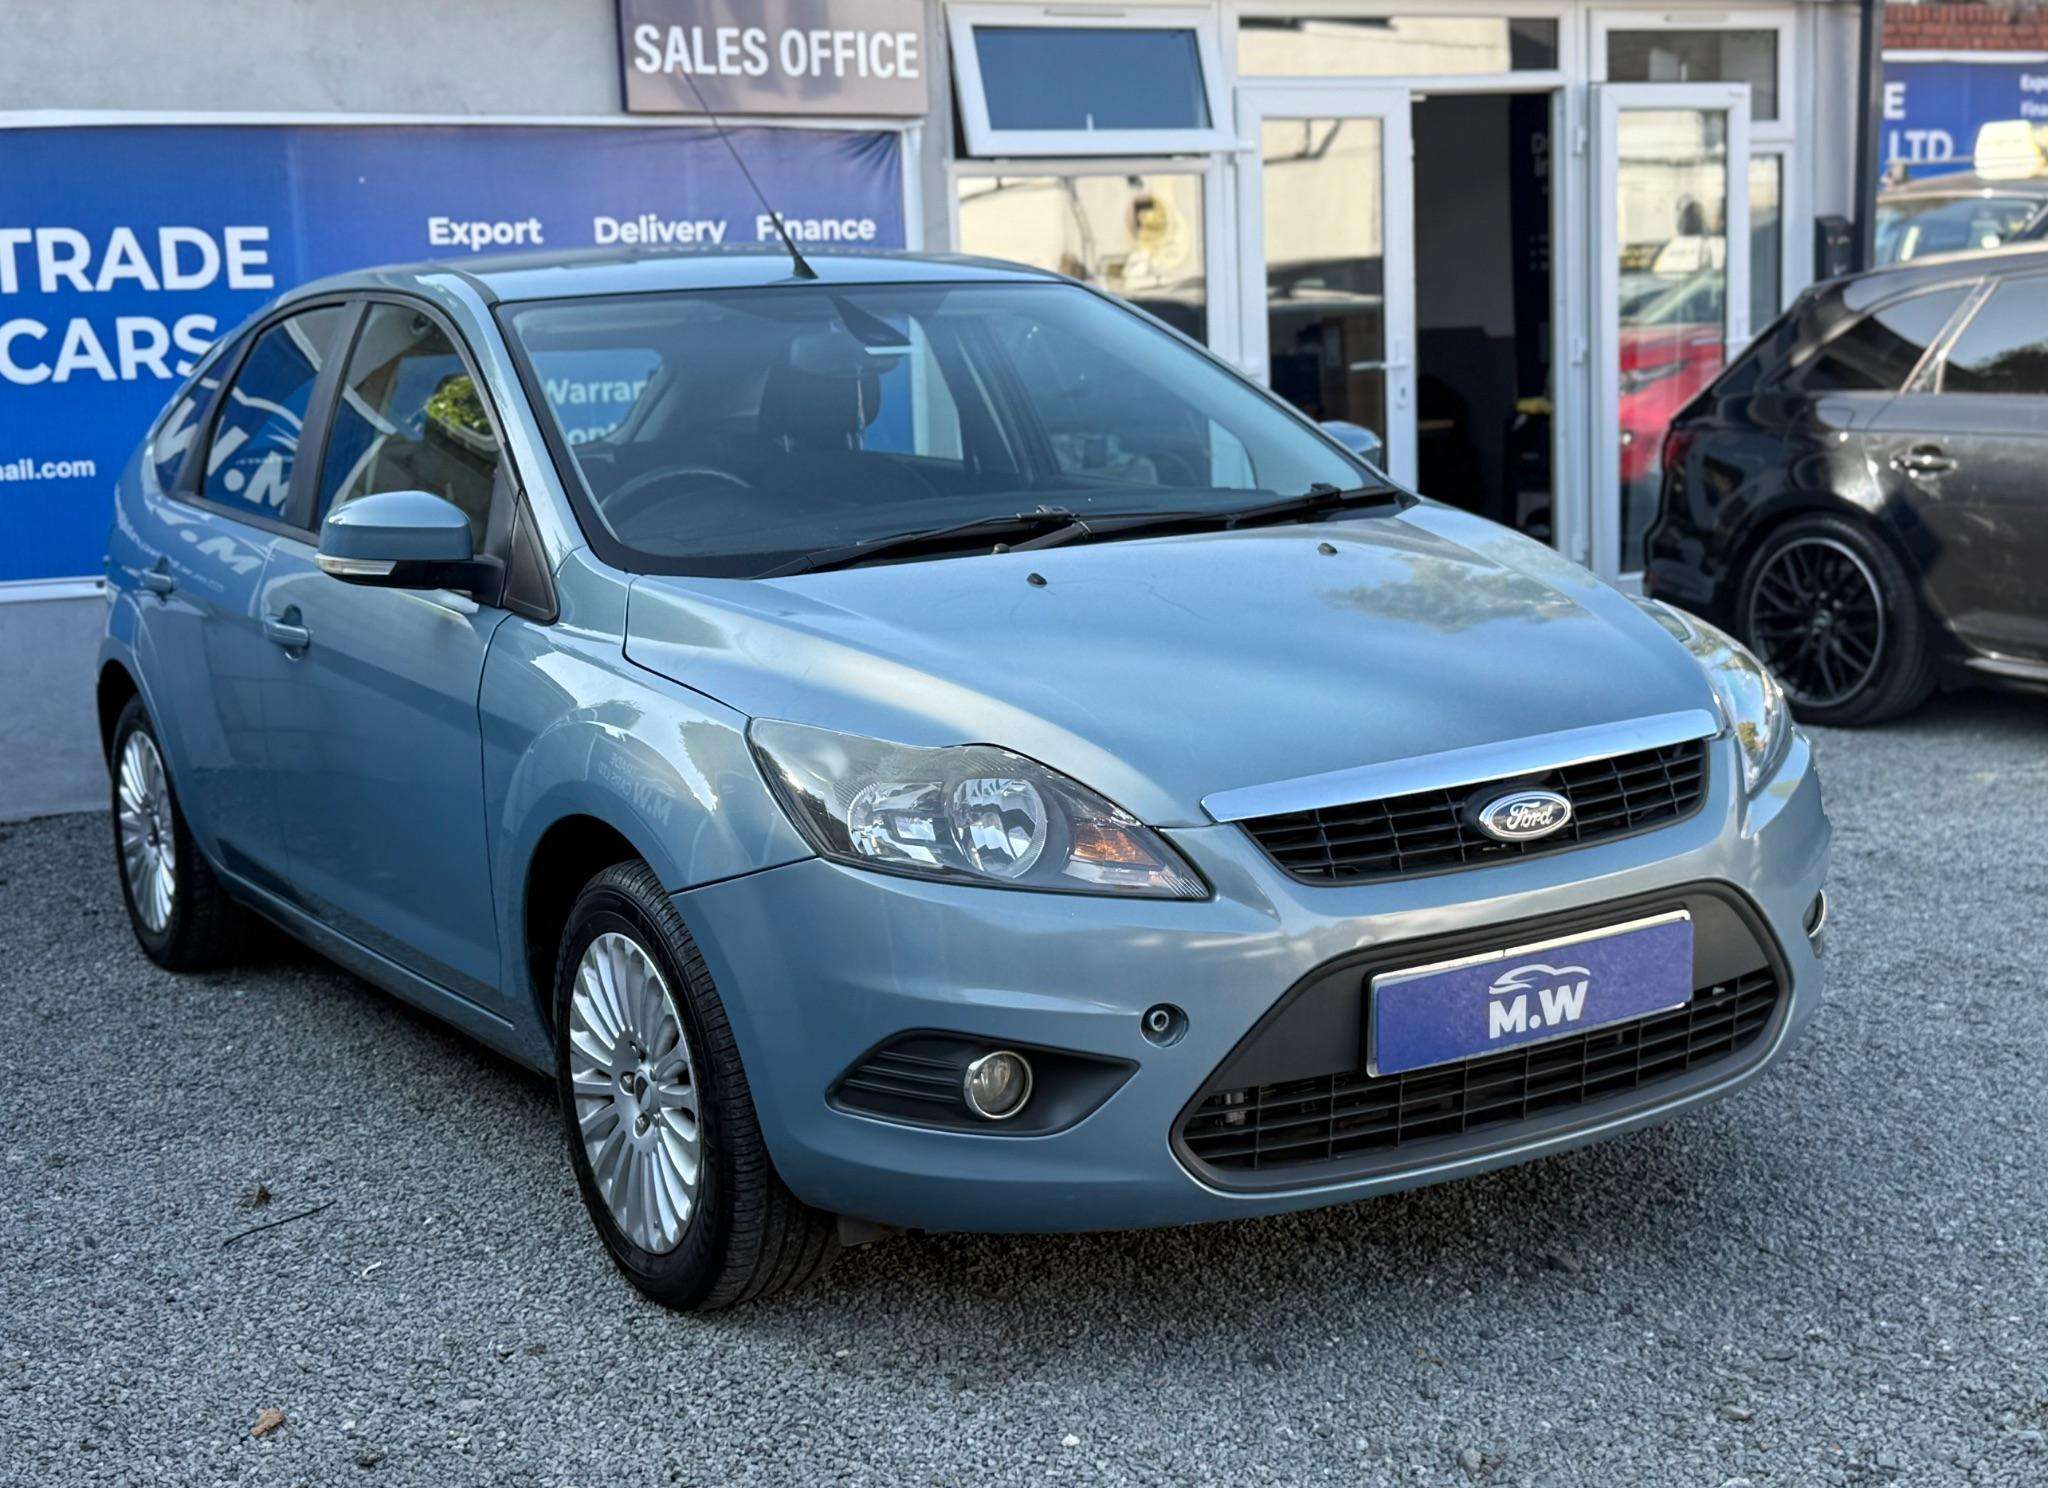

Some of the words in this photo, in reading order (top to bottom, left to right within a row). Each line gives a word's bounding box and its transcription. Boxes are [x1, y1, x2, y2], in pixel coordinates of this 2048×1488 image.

[634, 24, 769, 76] SALES
[779, 28, 919, 79] OFFICE
[1889, 130, 1953, 162] LTD
[428, 217, 543, 251] Export
[594, 213, 726, 244] Delivery
[756, 212, 877, 241] Finance
[0, 226, 274, 294] TRADE
[0, 314, 218, 386] CARS
[0, 457, 96, 482] ail.com
[1506, 801, 1554, 830] Ford
[1489, 981, 1589, 1040] M.W
